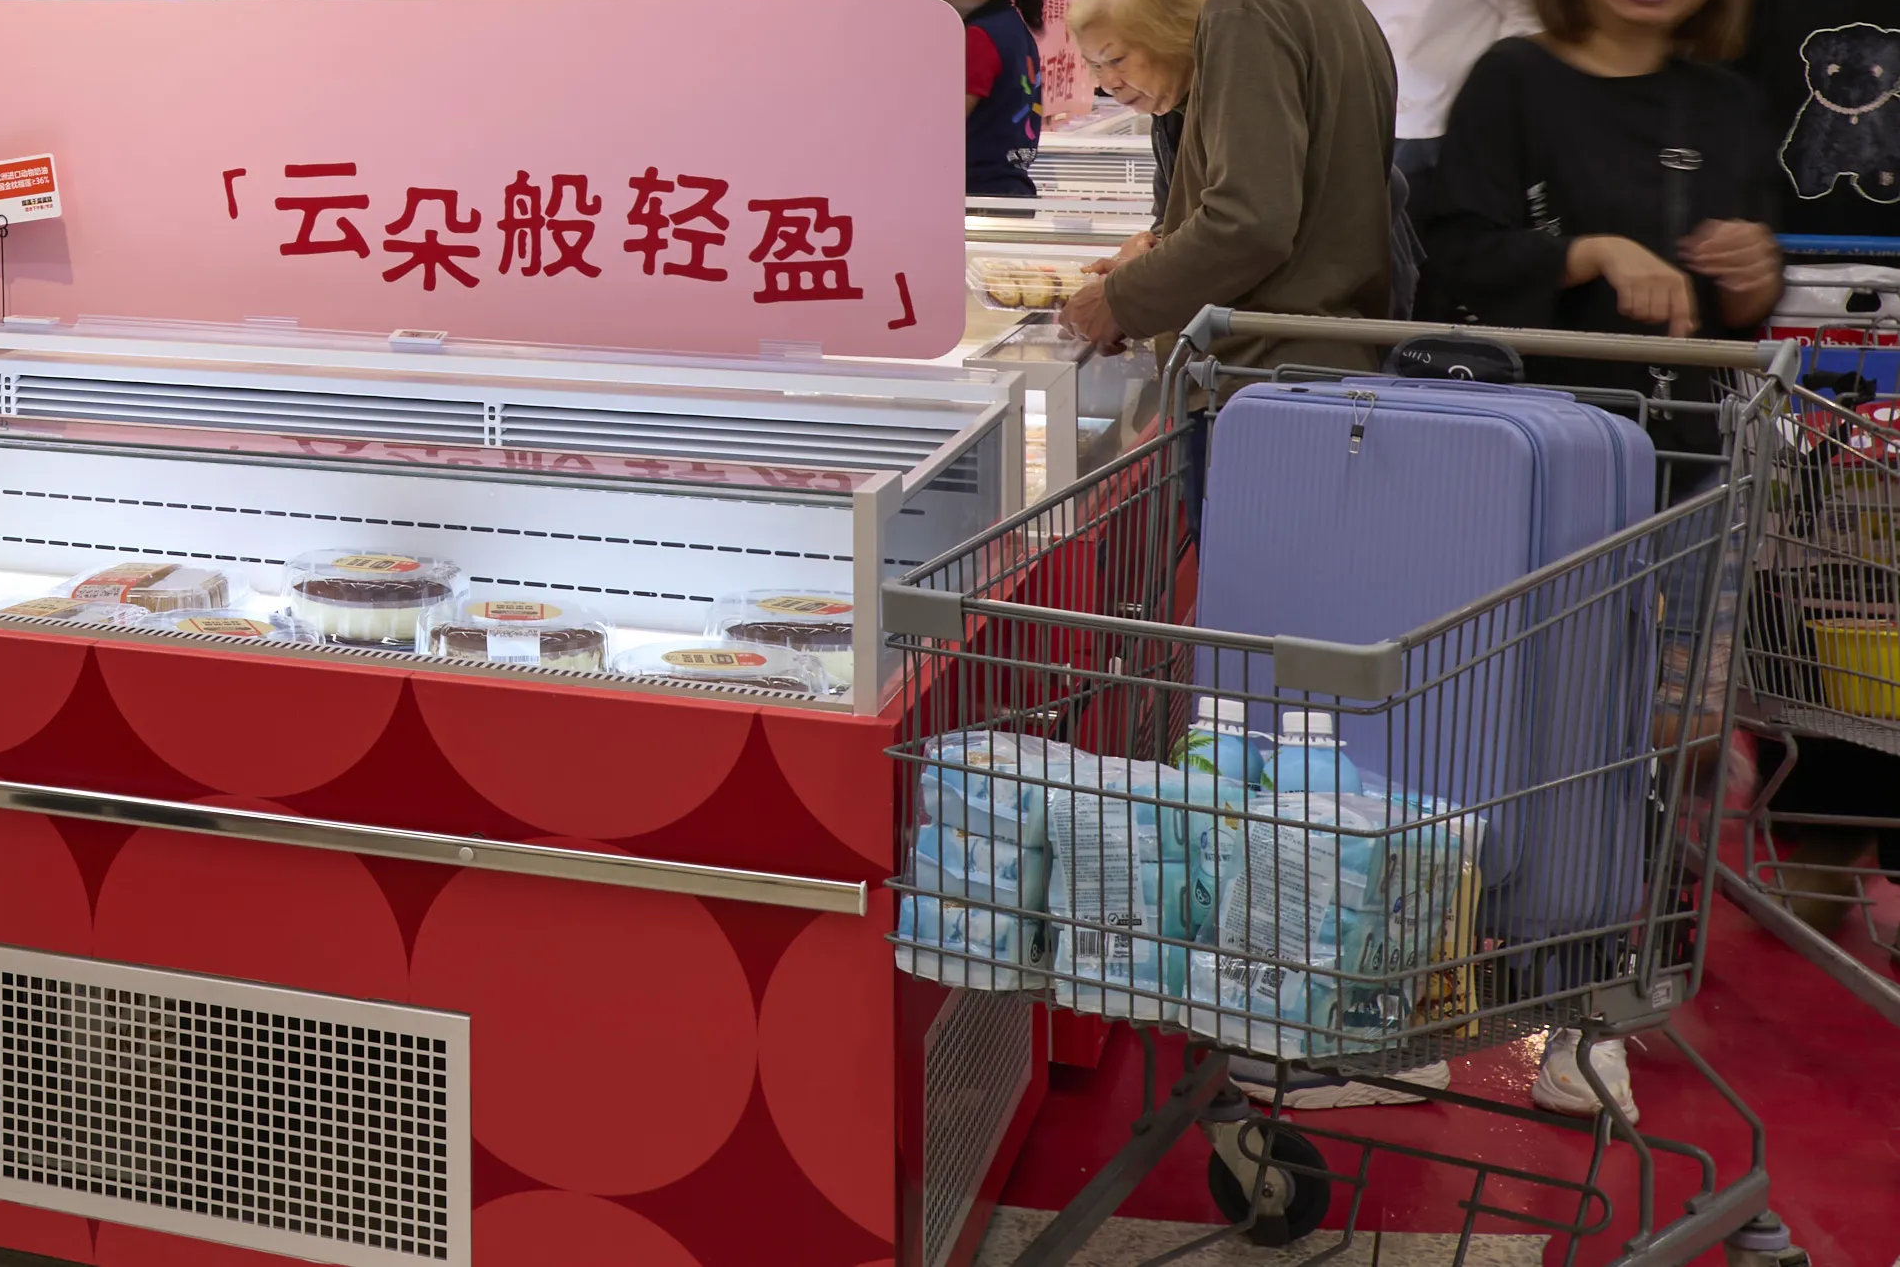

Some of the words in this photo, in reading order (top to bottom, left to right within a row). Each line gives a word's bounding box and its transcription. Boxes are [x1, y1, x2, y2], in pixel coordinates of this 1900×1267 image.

[222, 161, 917, 331] 「云朵般轻盈」
